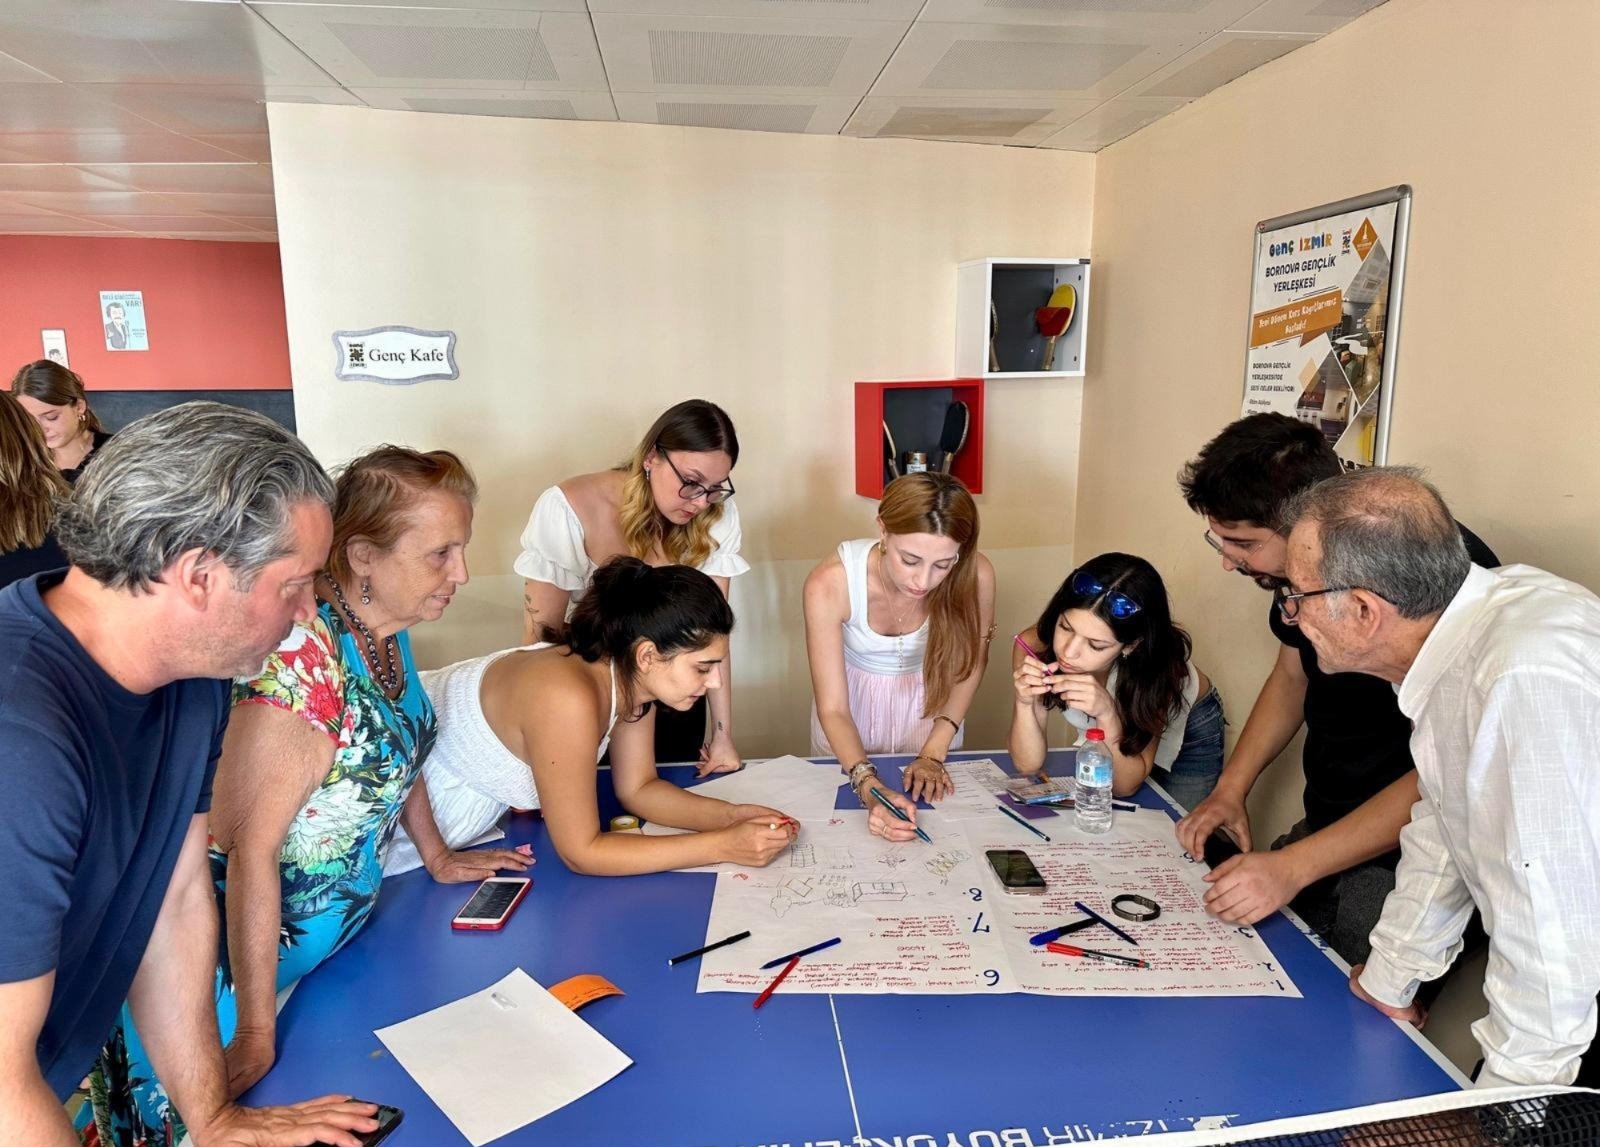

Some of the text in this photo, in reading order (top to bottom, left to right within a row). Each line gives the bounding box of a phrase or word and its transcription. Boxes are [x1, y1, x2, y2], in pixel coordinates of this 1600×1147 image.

[1265, 255, 1337, 278] BORNOVA GENÇLİK
[1273, 274, 1316, 293] YERLEŞKESİ
[368, 348, 444, 364] Genç Kafe
